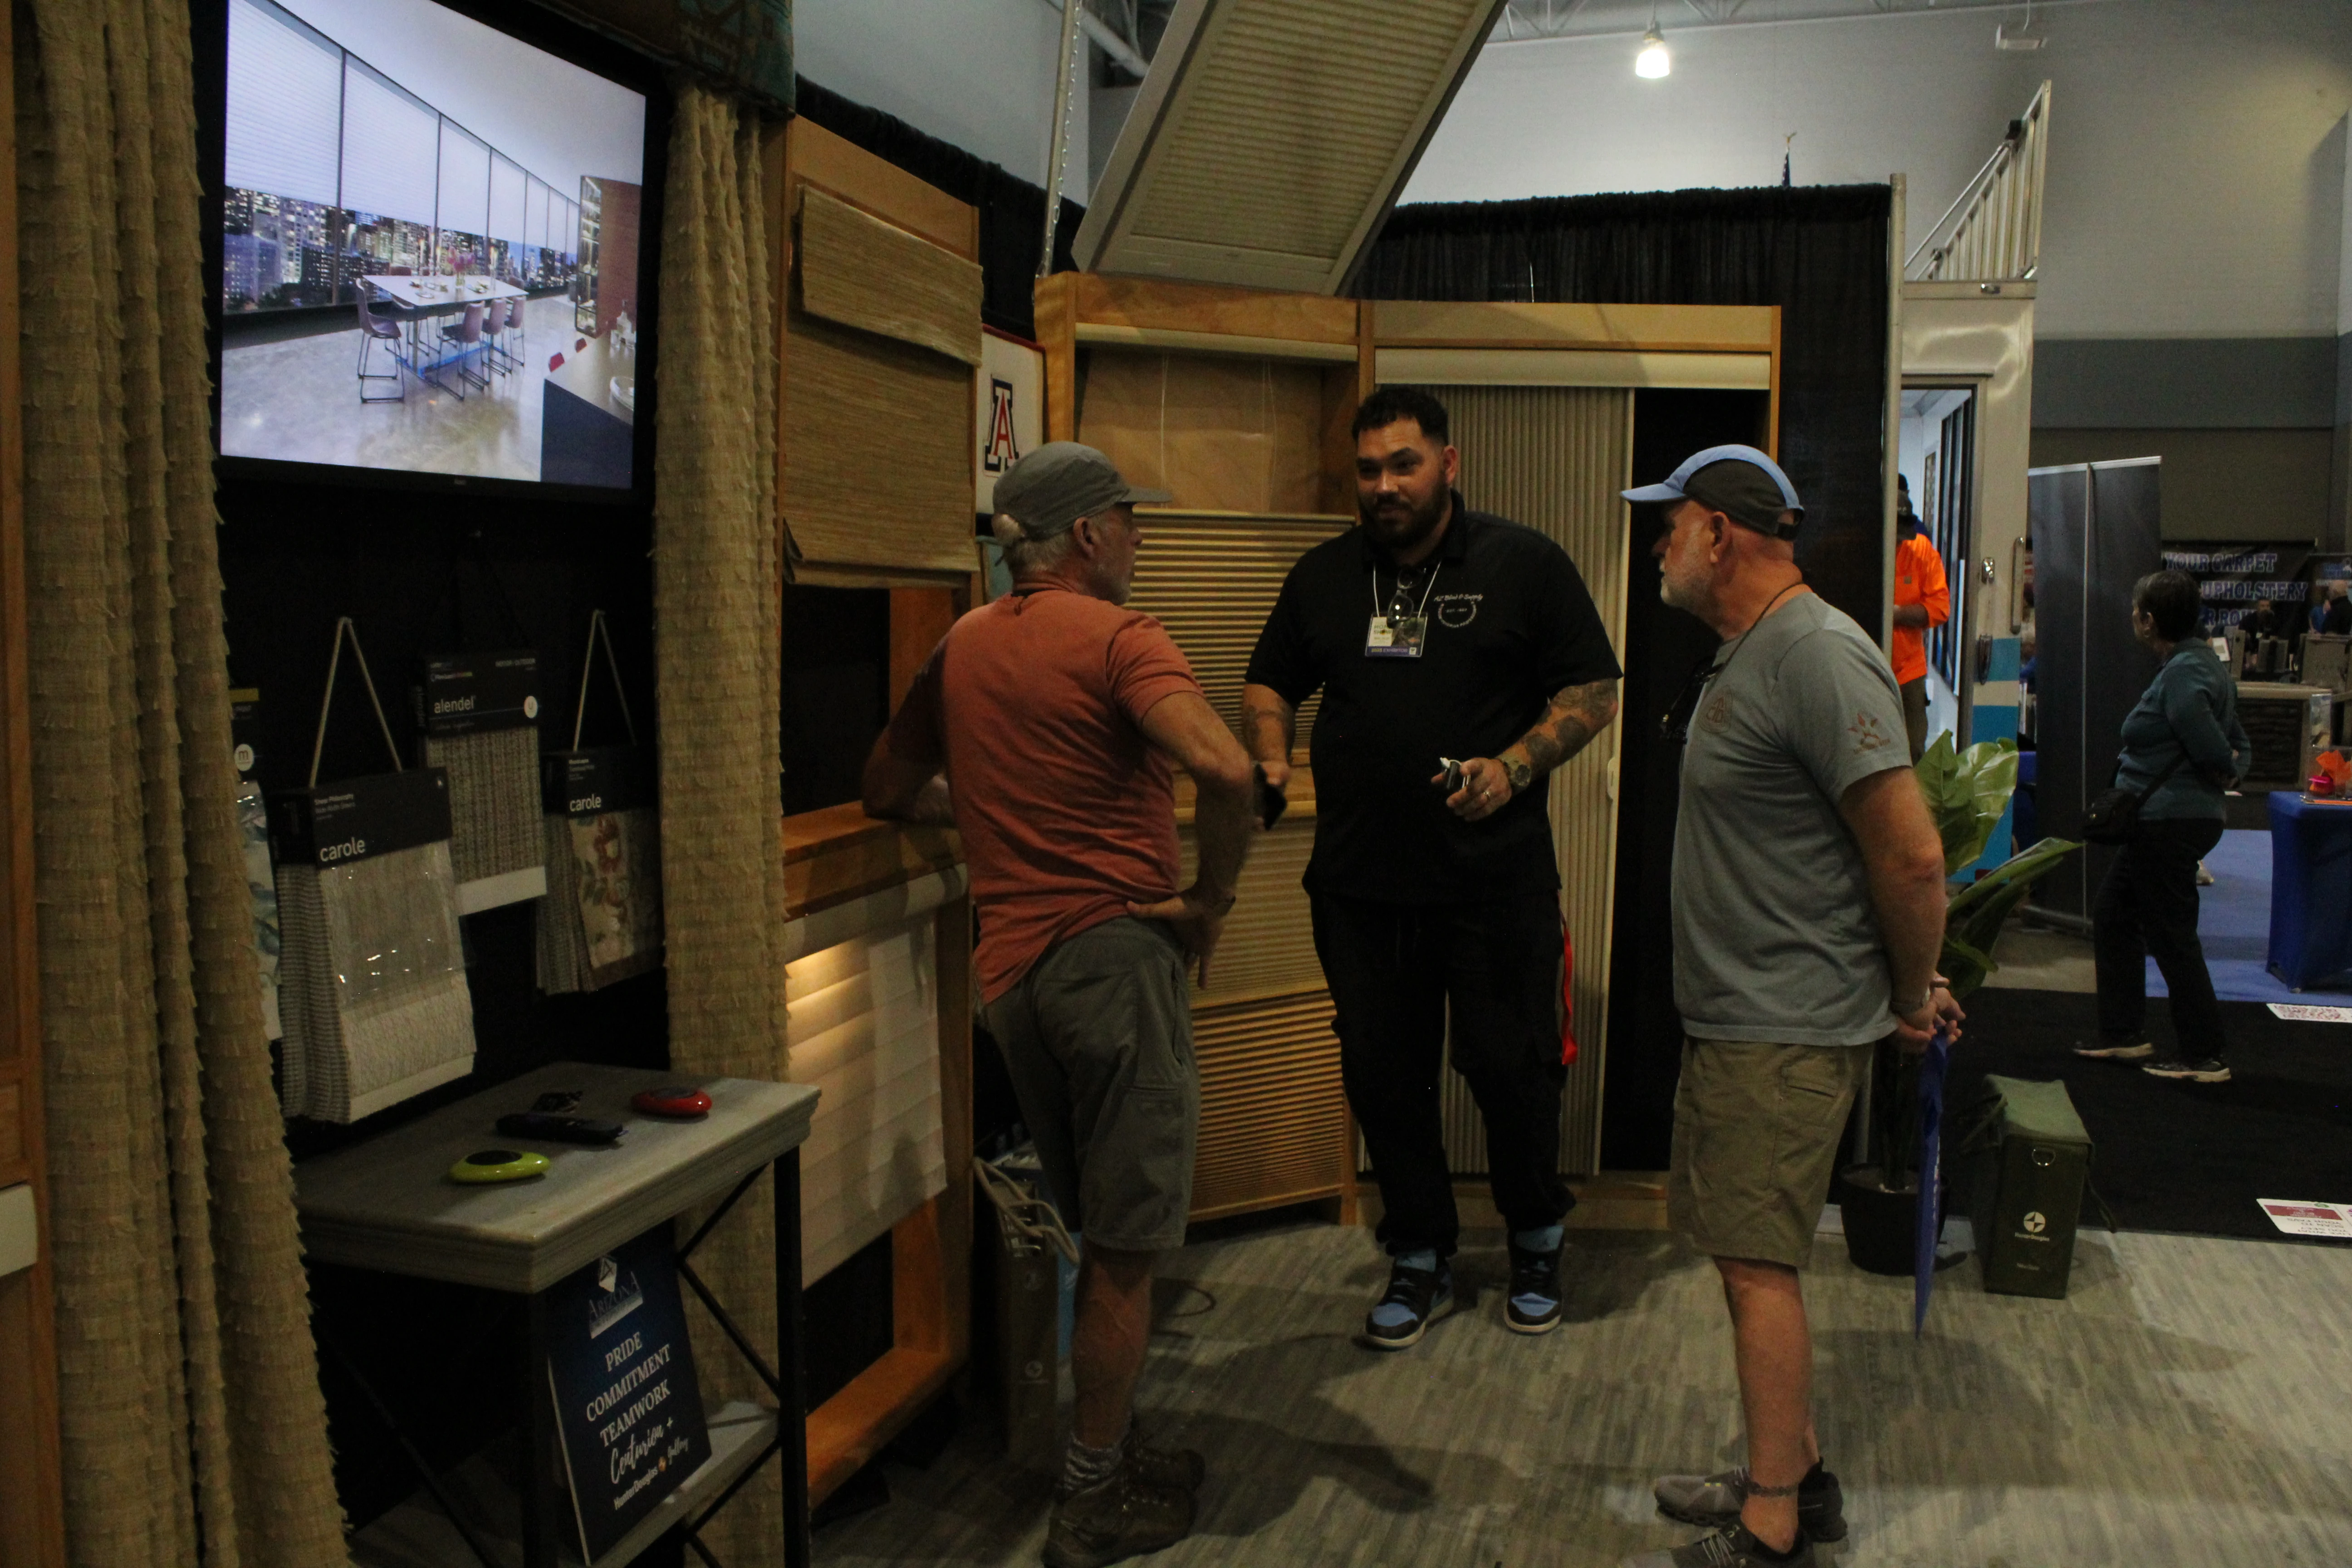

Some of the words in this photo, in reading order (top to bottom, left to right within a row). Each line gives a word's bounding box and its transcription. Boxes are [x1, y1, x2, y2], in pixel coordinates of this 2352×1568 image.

[985, 378, 1019, 473] A
[2165, 552, 2209, 571] YOUR
[2211, 553, 2278, 573] CARPET
[2201, 580, 2309, 602] UPHOLSTERY
[434, 695, 474, 714] alendel
[569, 794, 602, 812] carole
[319, 837, 366, 862] carole
[605, 1332, 642, 1372] PRIDE
[586, 1343, 670, 1422] COMMITMENT
[600, 1379, 671, 1447] TEAMWORK
